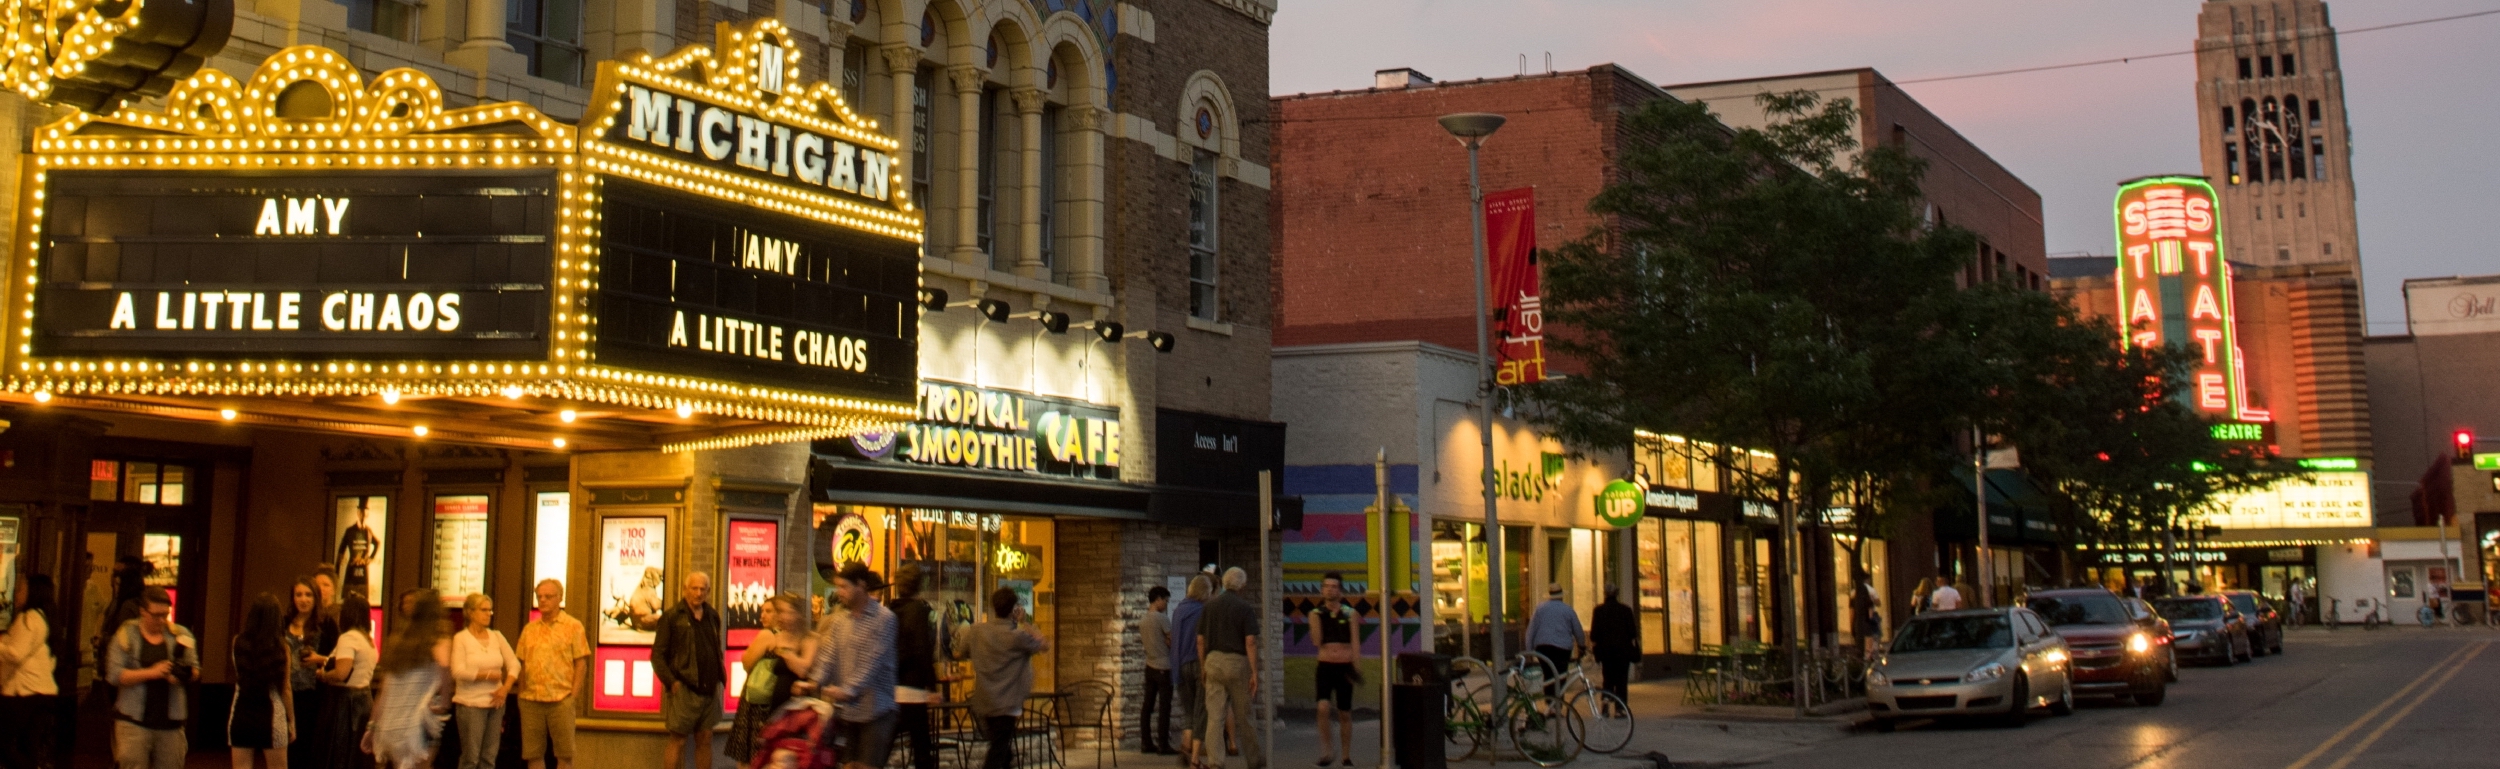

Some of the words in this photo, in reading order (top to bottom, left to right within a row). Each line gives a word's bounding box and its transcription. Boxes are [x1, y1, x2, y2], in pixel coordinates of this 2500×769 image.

[758, 42, 784, 94] M
[628, 86, 890, 201] MICHIGAN
[255, 198, 350, 235] AMY
[745, 234, 799, 276] AMY
[110, 292, 136, 330] A
[155, 292, 301, 330] LITTLE
[322, 292, 461, 332] CHAOS
[1505, 290, 1543, 346] fair
[2185, 197, 2227, 410] STATE
[2447, 292, 2495, 319] Bell
[671, 310, 688, 348] A
[699, 314, 783, 362] LITTLE
[793, 330, 868, 373] CHAOS
[1496, 339, 1547, 385] art
[919, 381, 1030, 432] TROPICAL
[907, 424, 1037, 471] SMOOTHIE
[1043, 411, 1120, 468] CAFE
[1193, 431, 1217, 451] Access
[1223, 433, 1238, 453] Int'l
[1604, 490, 1637, 499] salads
[1605, 498, 1637, 518] UP
[1646, 490, 1675, 509] American
[1675, 491, 1699, 513] Apparel
[627, 527, 646, 539] 100
[620, 548, 645, 559] MAN
[997, 543, 1029, 573] OPEN
[2099, 552, 2148, 563] rban
